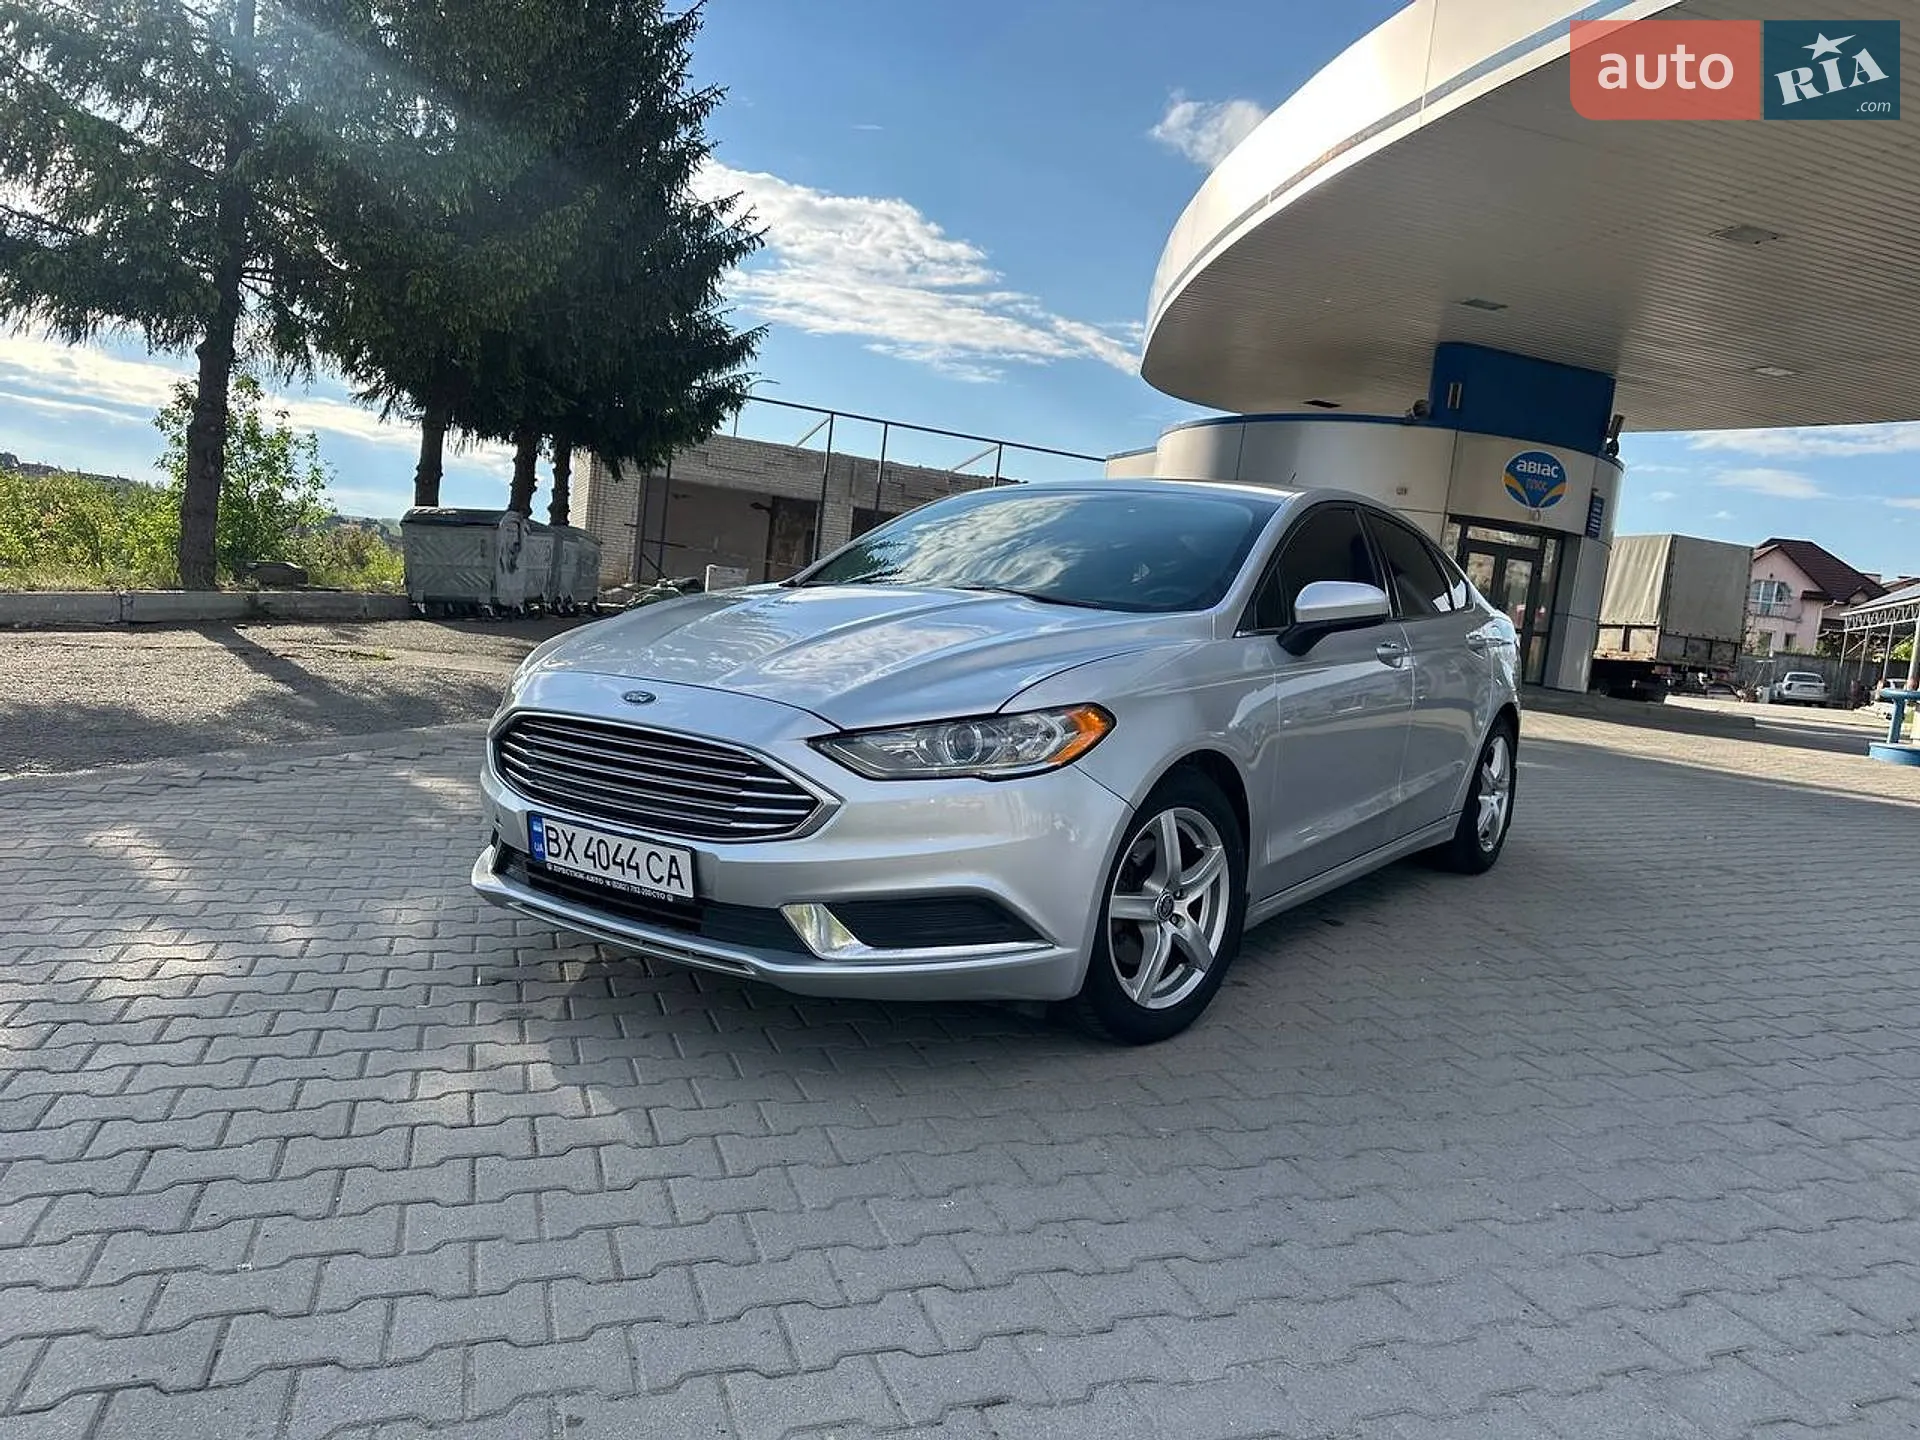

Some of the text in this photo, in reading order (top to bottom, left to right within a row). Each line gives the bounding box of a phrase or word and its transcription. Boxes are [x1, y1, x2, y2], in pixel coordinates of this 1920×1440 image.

[545, 825, 685, 889] BX 4044 CA
